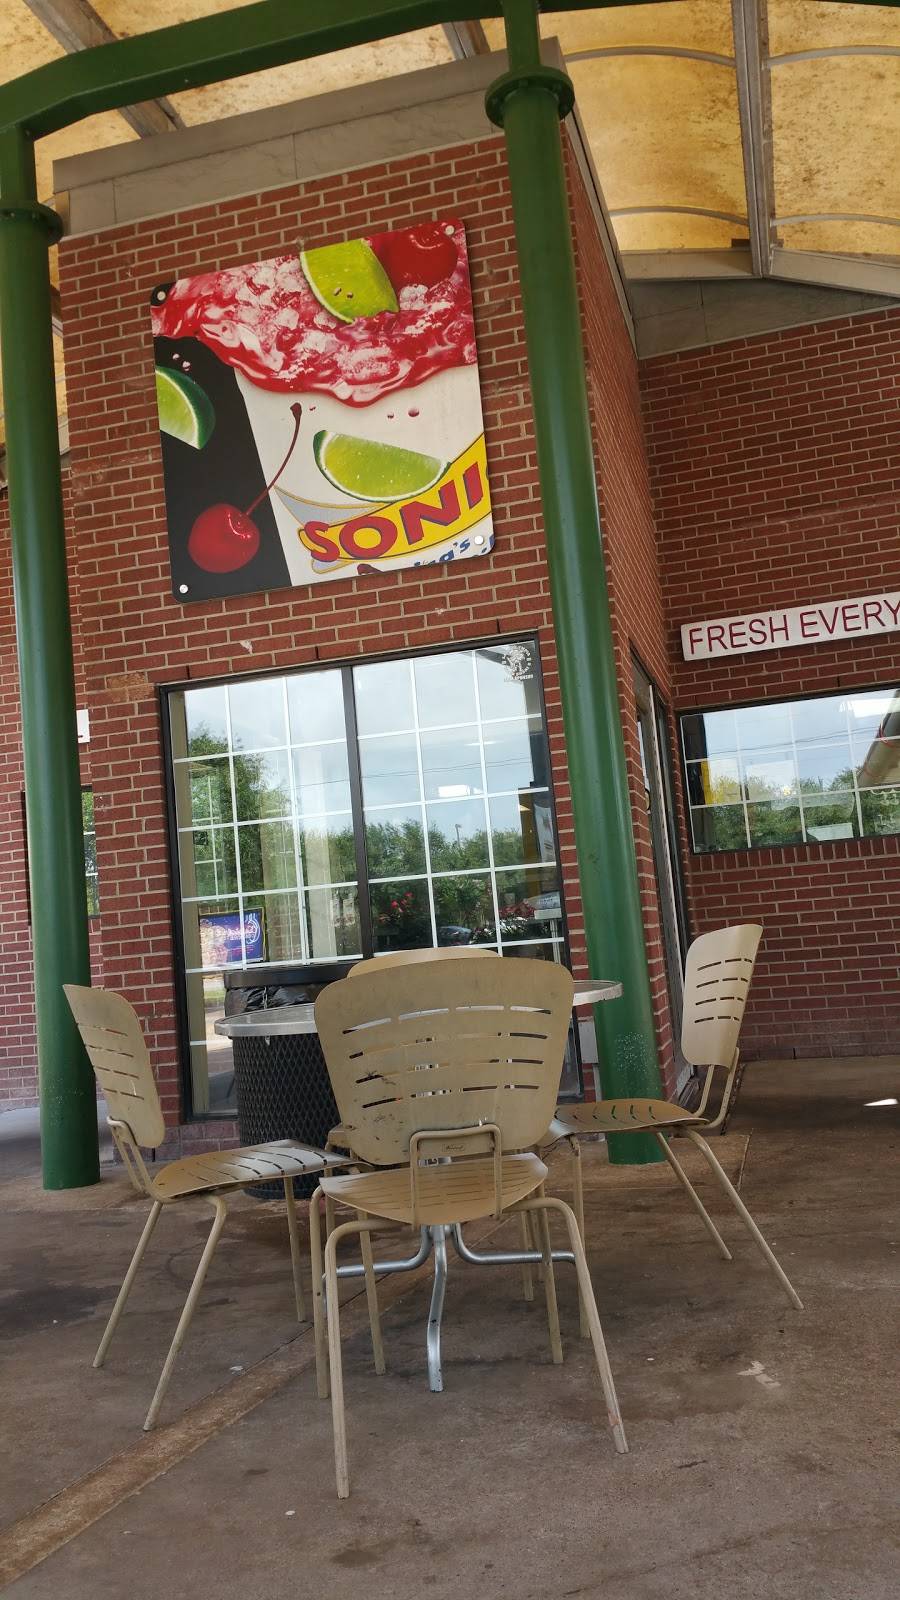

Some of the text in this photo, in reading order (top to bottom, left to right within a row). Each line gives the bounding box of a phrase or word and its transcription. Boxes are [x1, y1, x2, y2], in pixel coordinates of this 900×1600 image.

[303, 462, 487, 562] SONI
[688, 599, 900, 655] FRESH EVERY
